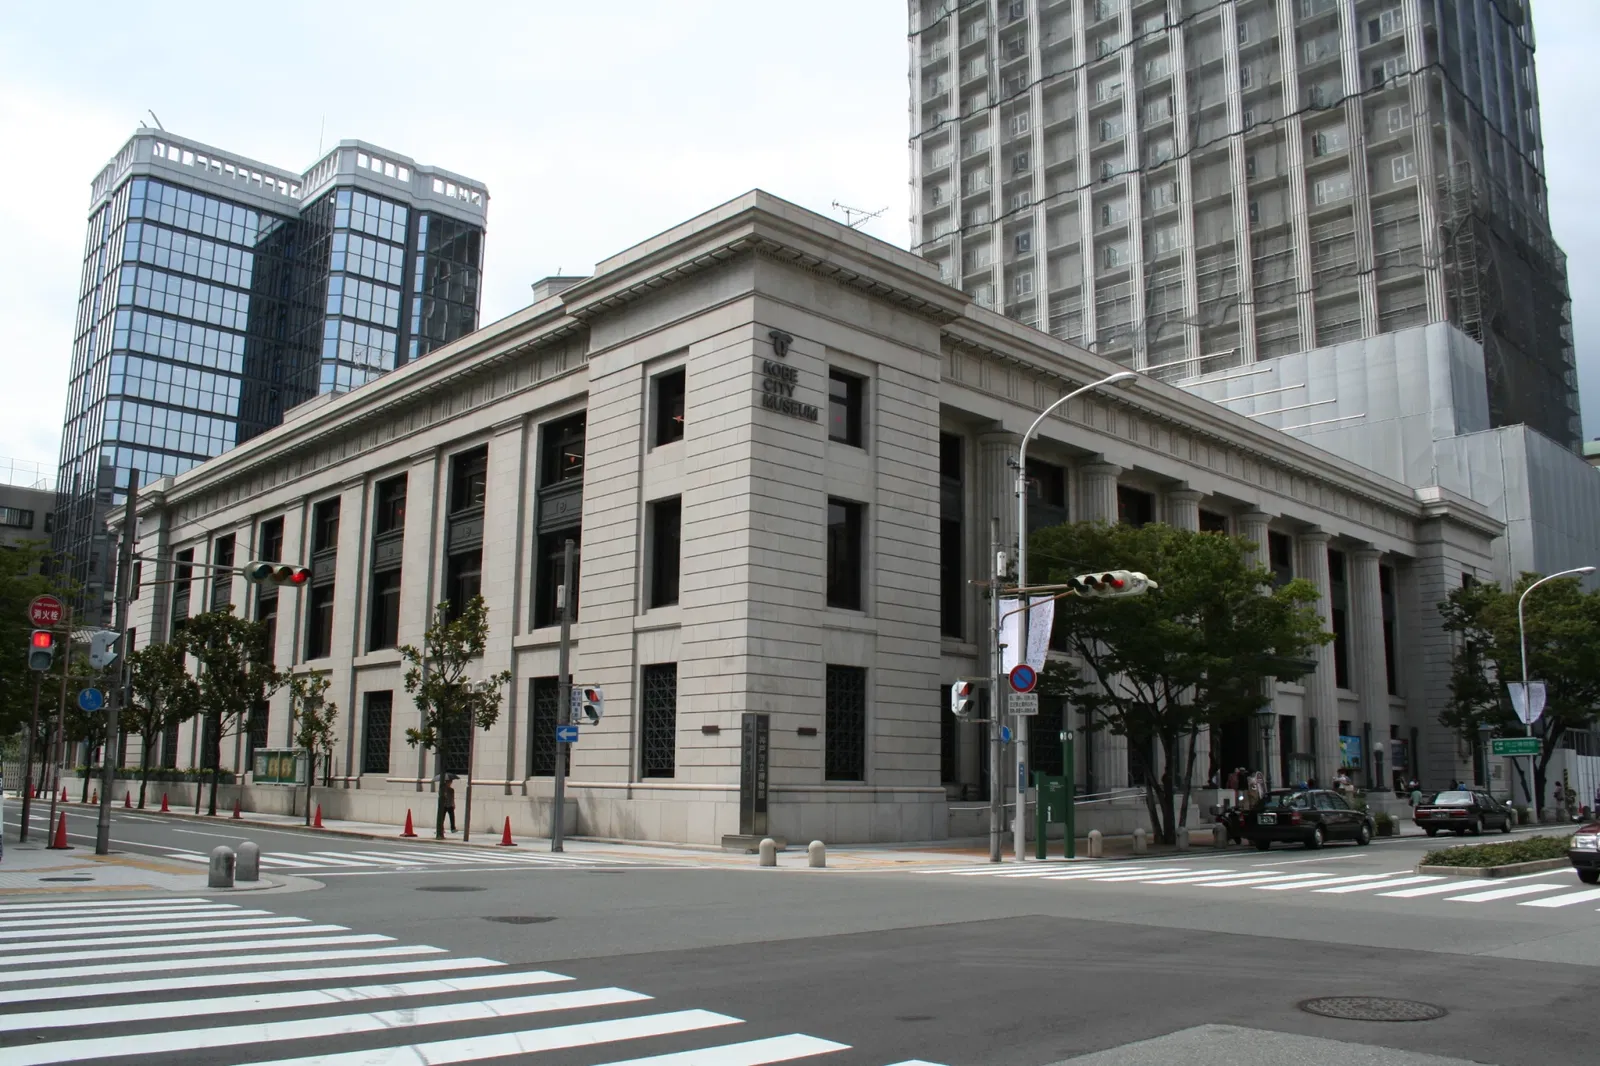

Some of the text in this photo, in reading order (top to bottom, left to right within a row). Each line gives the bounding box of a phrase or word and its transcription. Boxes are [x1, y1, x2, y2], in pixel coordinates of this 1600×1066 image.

[763, 360, 799, 383] KOBE
[763, 378, 795, 397] CITY
[762, 394, 819, 421] MUSEUM
[33, 609, 59, 621] 消火栓
